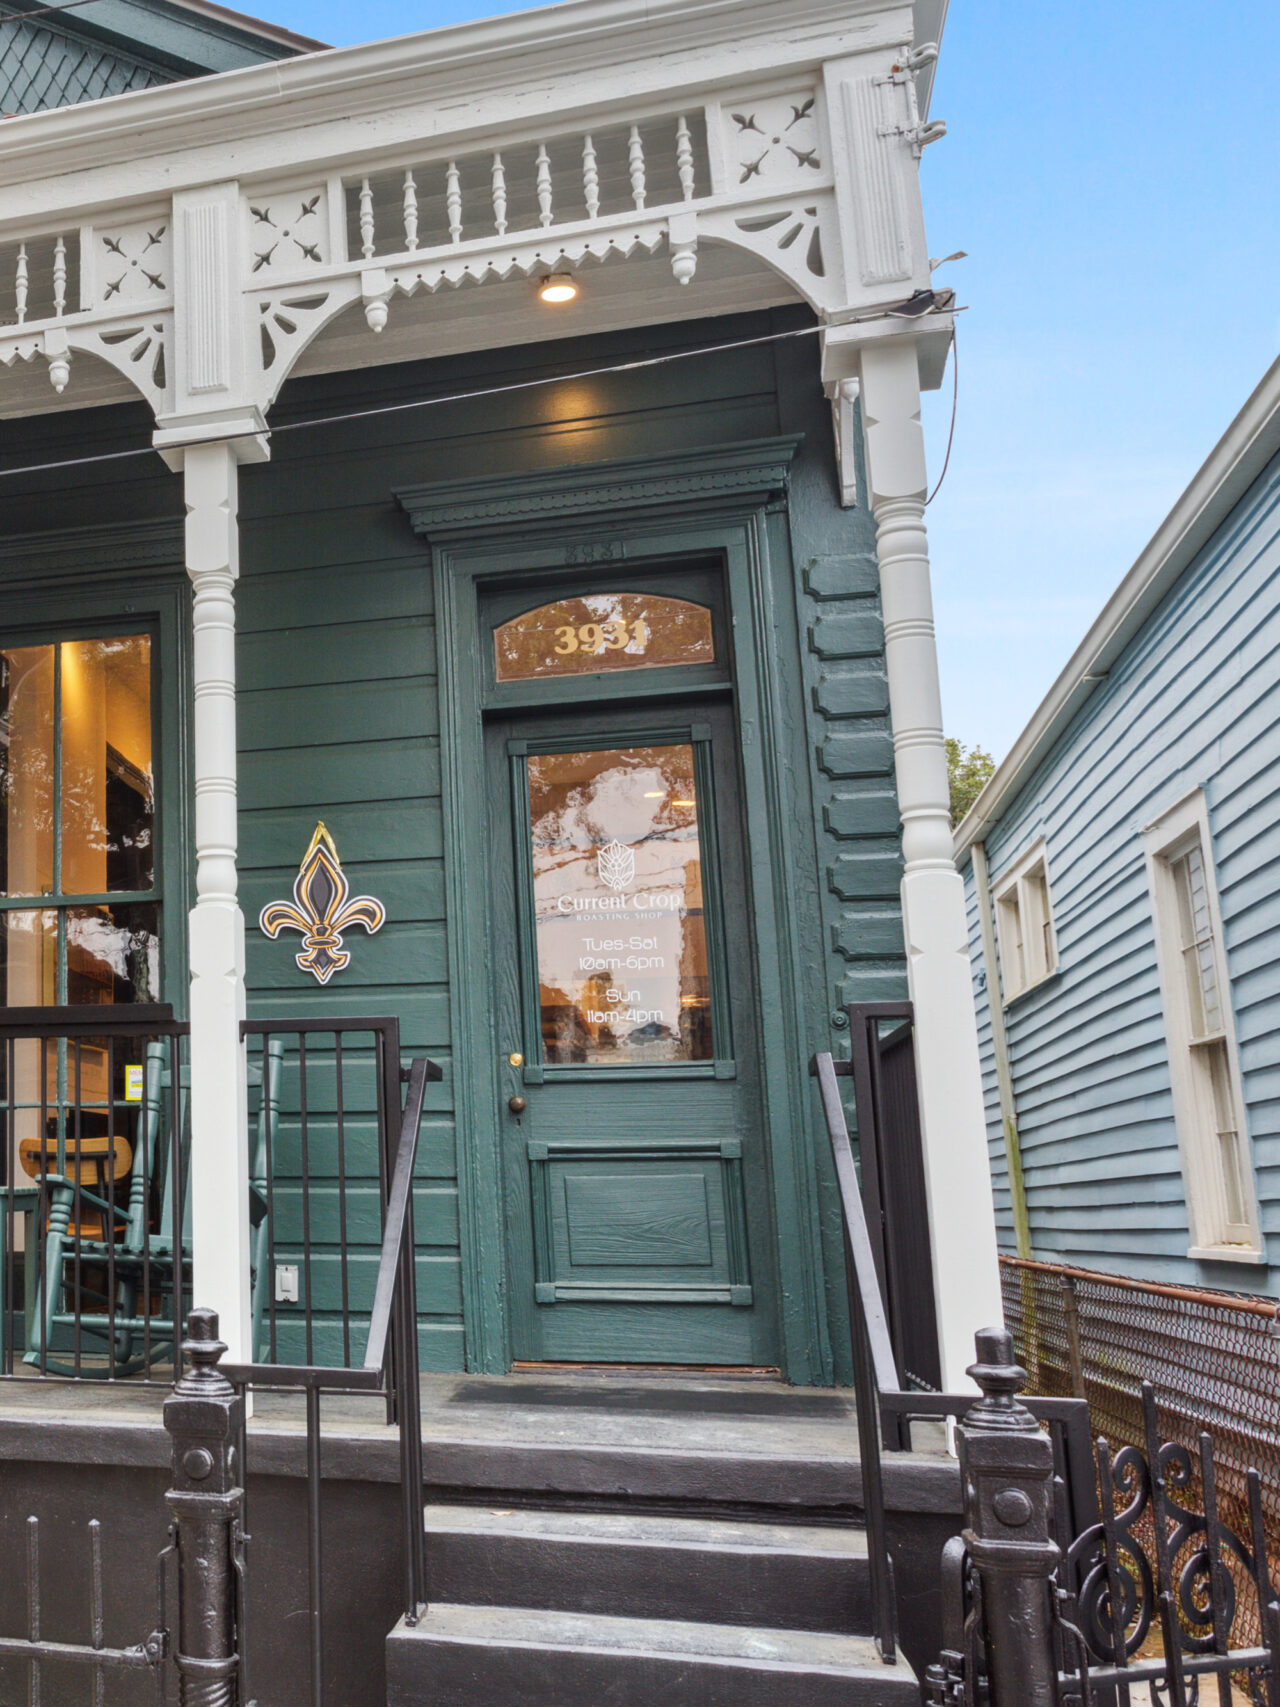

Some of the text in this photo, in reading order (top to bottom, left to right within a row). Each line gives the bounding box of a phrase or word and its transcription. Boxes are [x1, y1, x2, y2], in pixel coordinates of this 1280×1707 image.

[554, 619, 648, 655] 3931
[558, 893, 680, 912] Current Crop
[576, 911, 663, 921] ROASTING SHOP
[582, 936, 658, 951] Tues-Sat
[580, 955, 664, 970] 10am-6pm
[606, 989, 641, 1002] Sun
[587, 1008, 663, 1023] 11am-4pm
